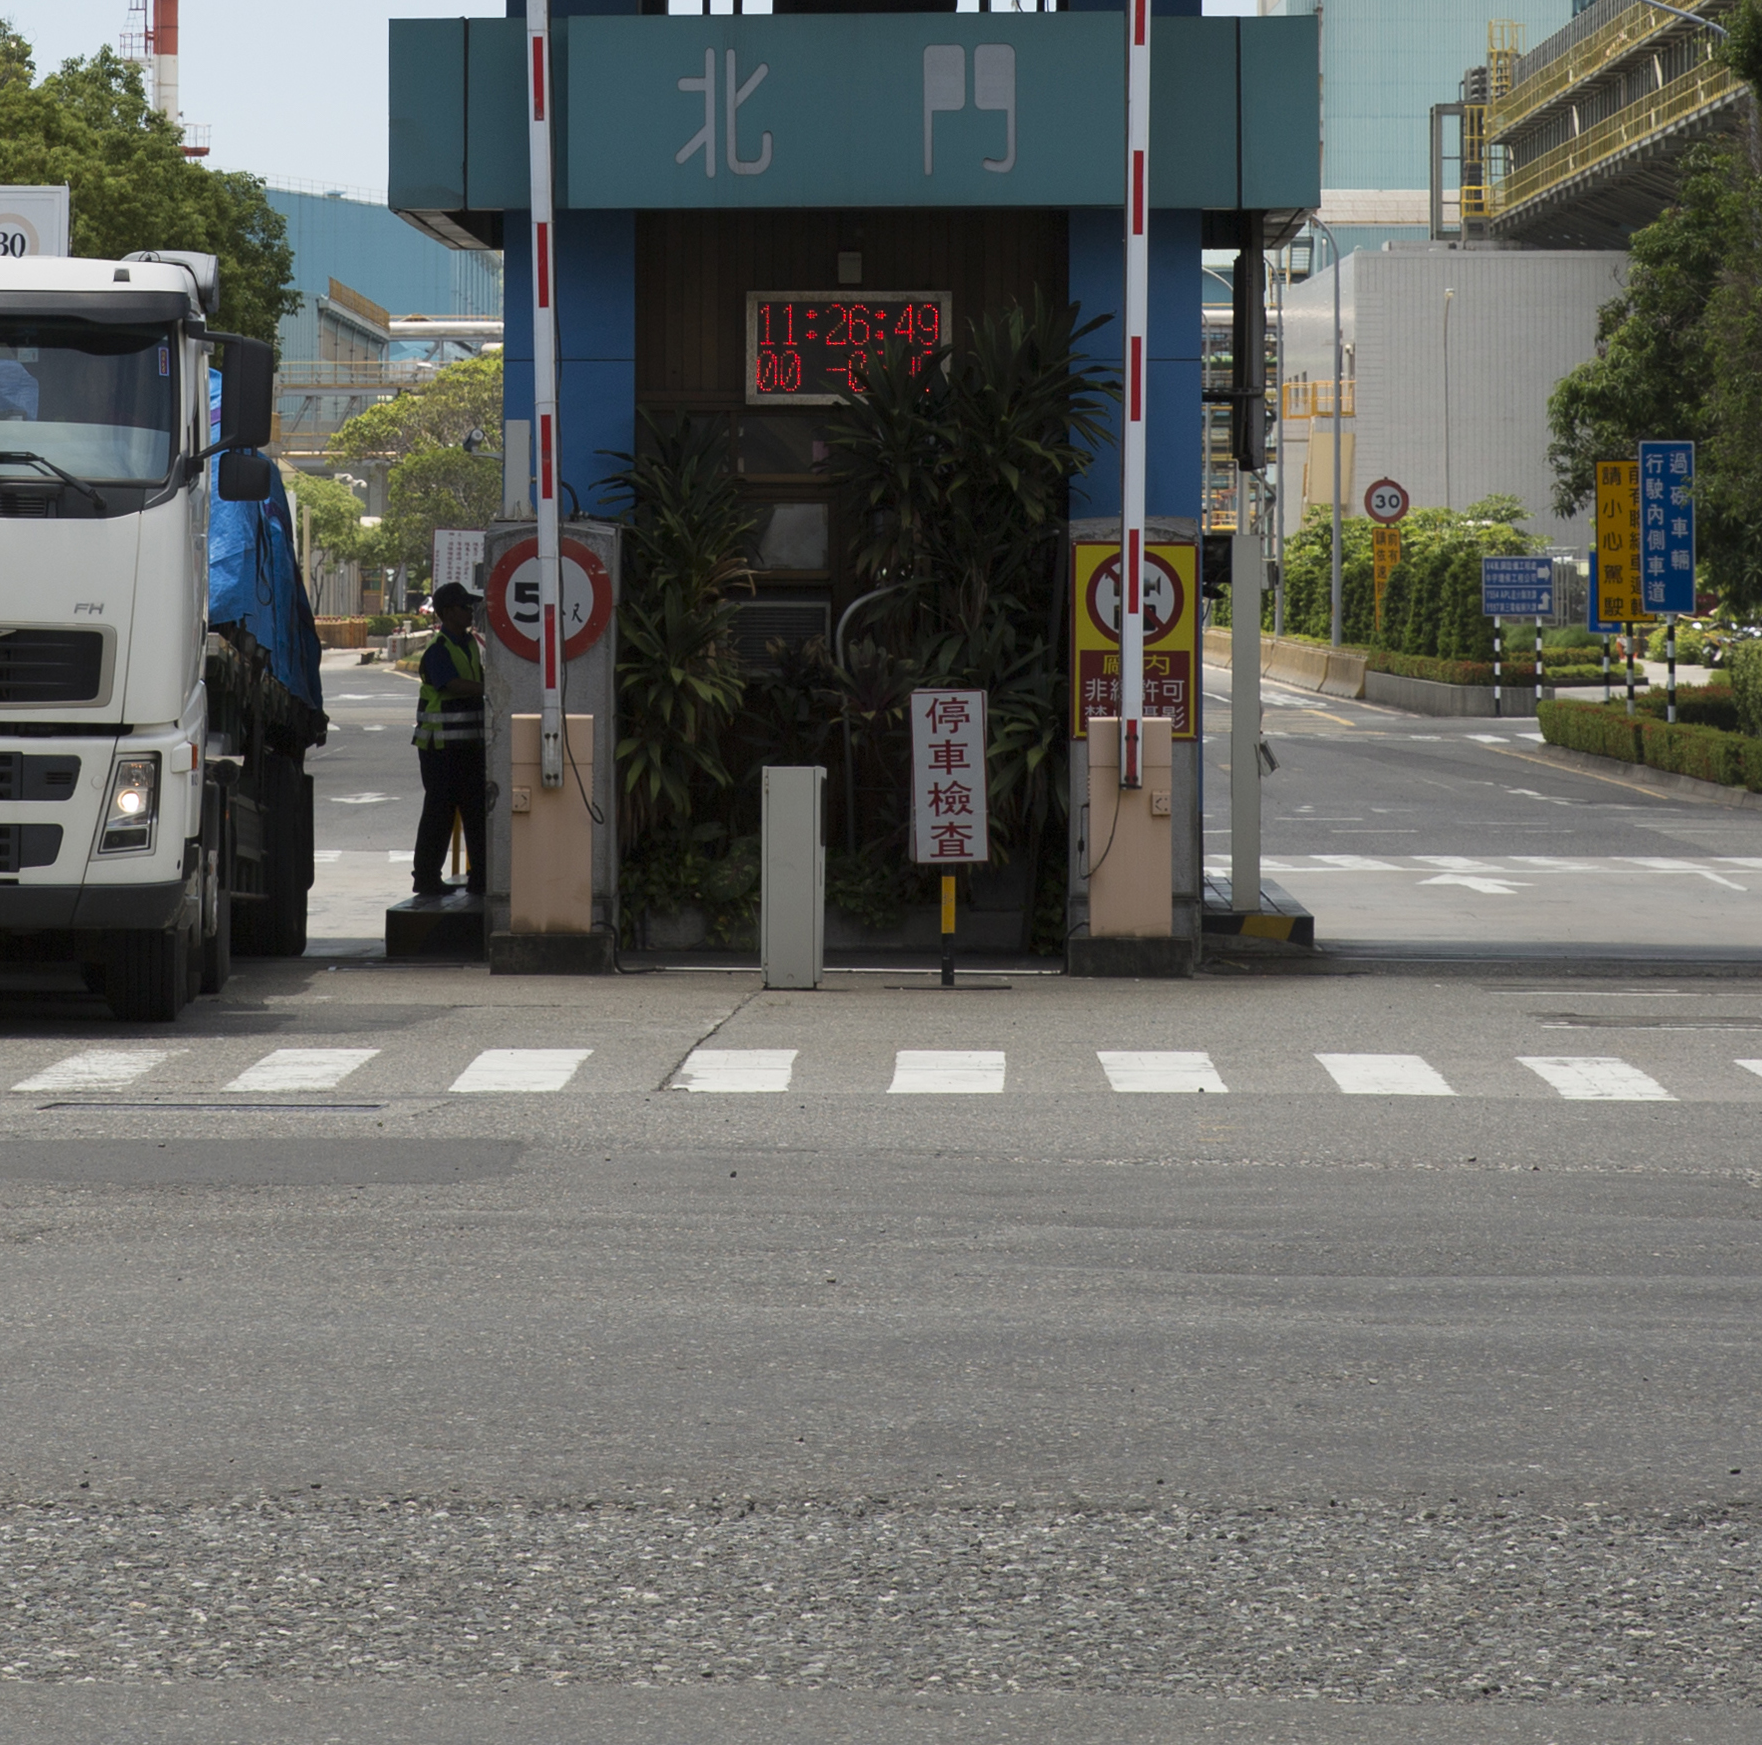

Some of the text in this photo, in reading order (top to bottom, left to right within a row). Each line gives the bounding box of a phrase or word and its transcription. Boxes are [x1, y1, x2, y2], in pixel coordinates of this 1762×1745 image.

[759, 303, 939, 346] 11:26:49
[1375, 494, 1401, 509] 30
[1601, 466, 1624, 618] 請小心駕駛
[1645, 453, 1666, 604] 行駛內側車道
[74, 602, 105, 615] FH
[925, 696, 974, 858] 停車檢查
